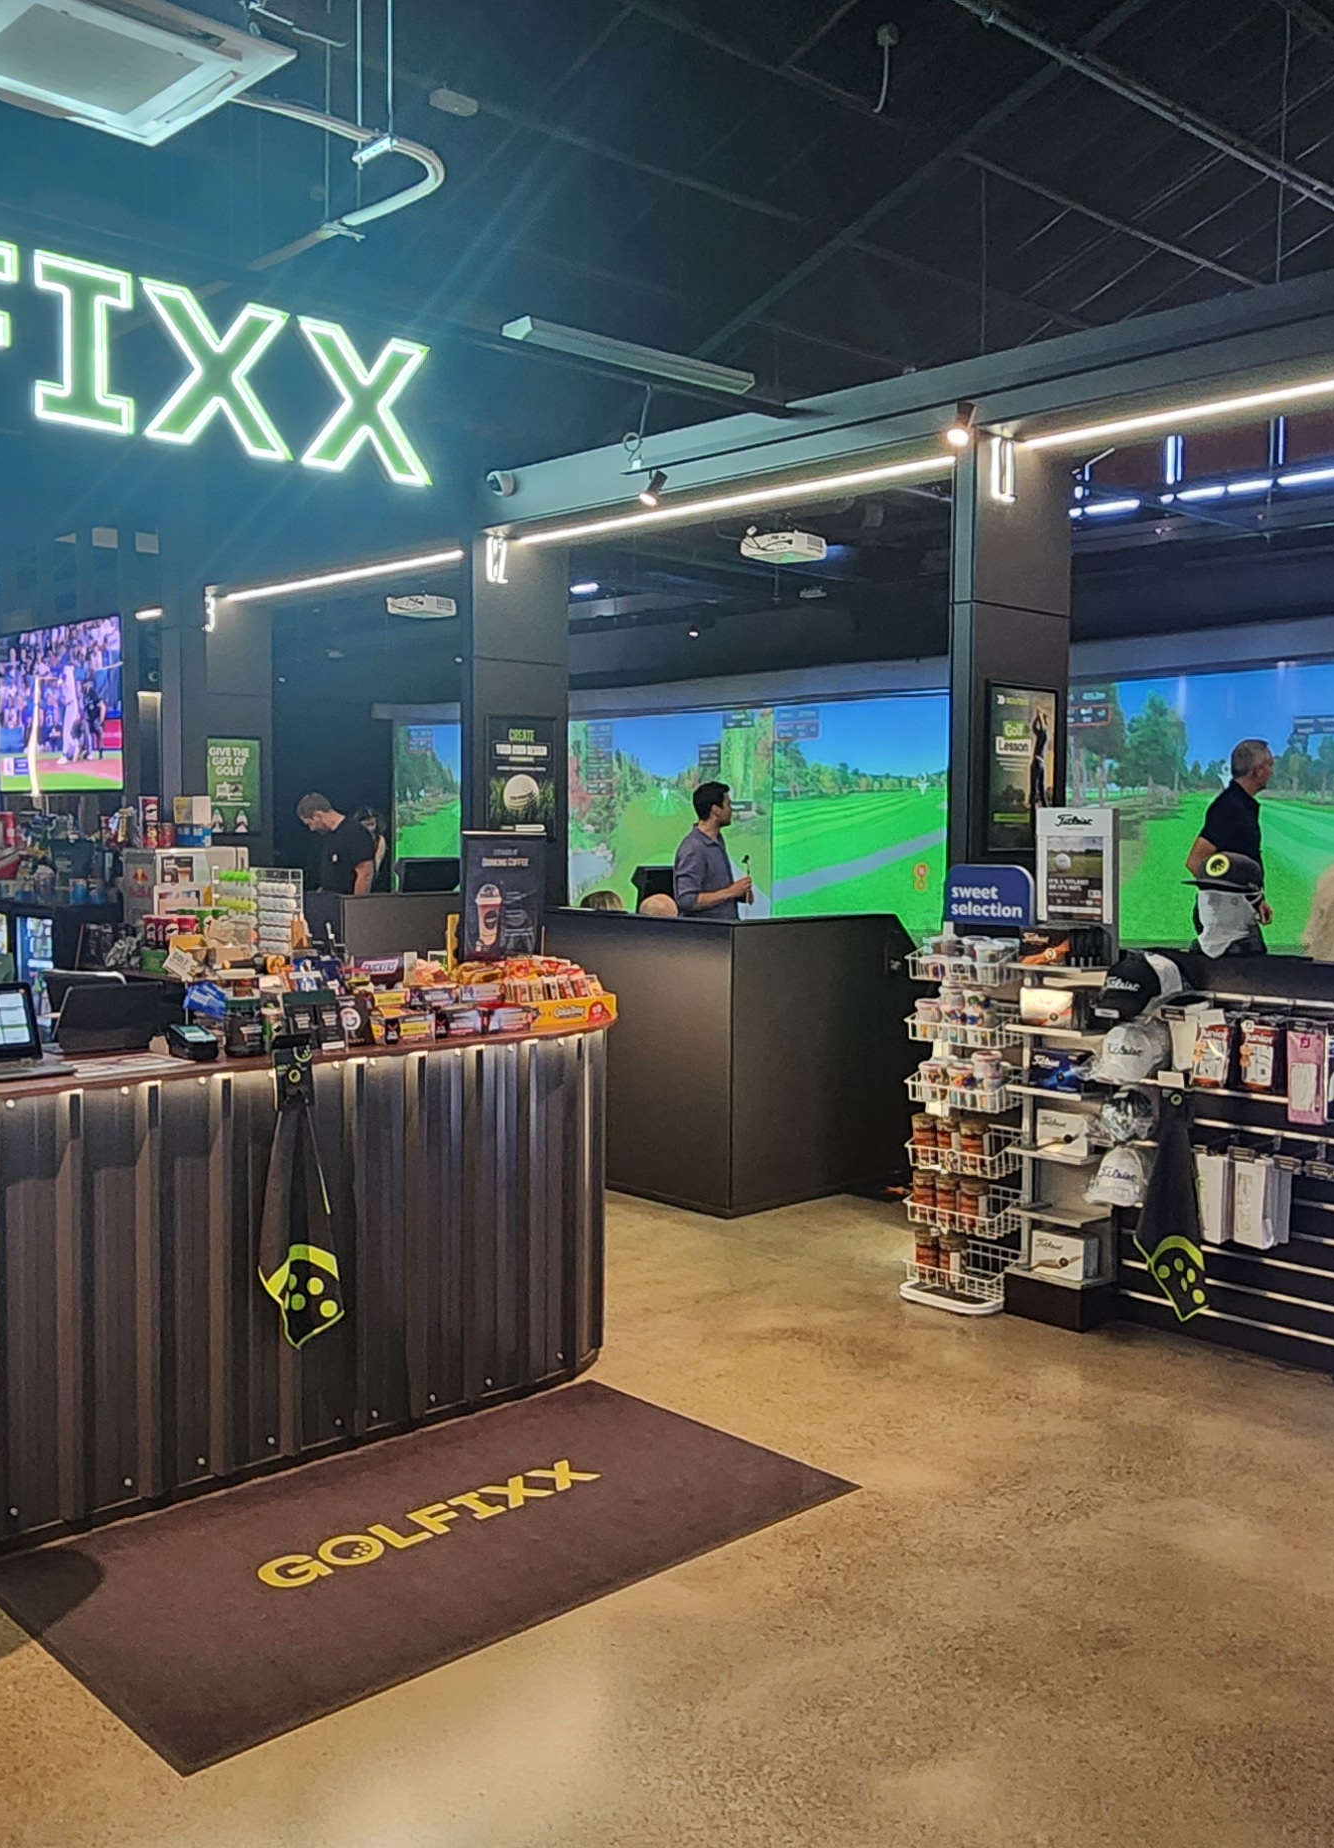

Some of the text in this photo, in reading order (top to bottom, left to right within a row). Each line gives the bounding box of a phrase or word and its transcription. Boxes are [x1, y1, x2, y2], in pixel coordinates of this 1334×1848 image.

[508, 728, 535, 742] CREATE
[1004, 724, 1024, 737] Golf
[998, 738, 1029, 752] Lesson
[208, 746, 250, 758] GIVE THE
[211, 757, 247, 767] GIFT OF
[216, 766, 244, 777] GOLF!
[1054, 813, 1094, 827] Titleist
[951, 886, 999, 900] sweet
[951, 901, 1023, 919] selection
[1201, 1027, 1228, 1040] Junior
[1245, 1031, 1275, 1044] Junior
[257, 1458, 604, 1590] GOLFIXX
